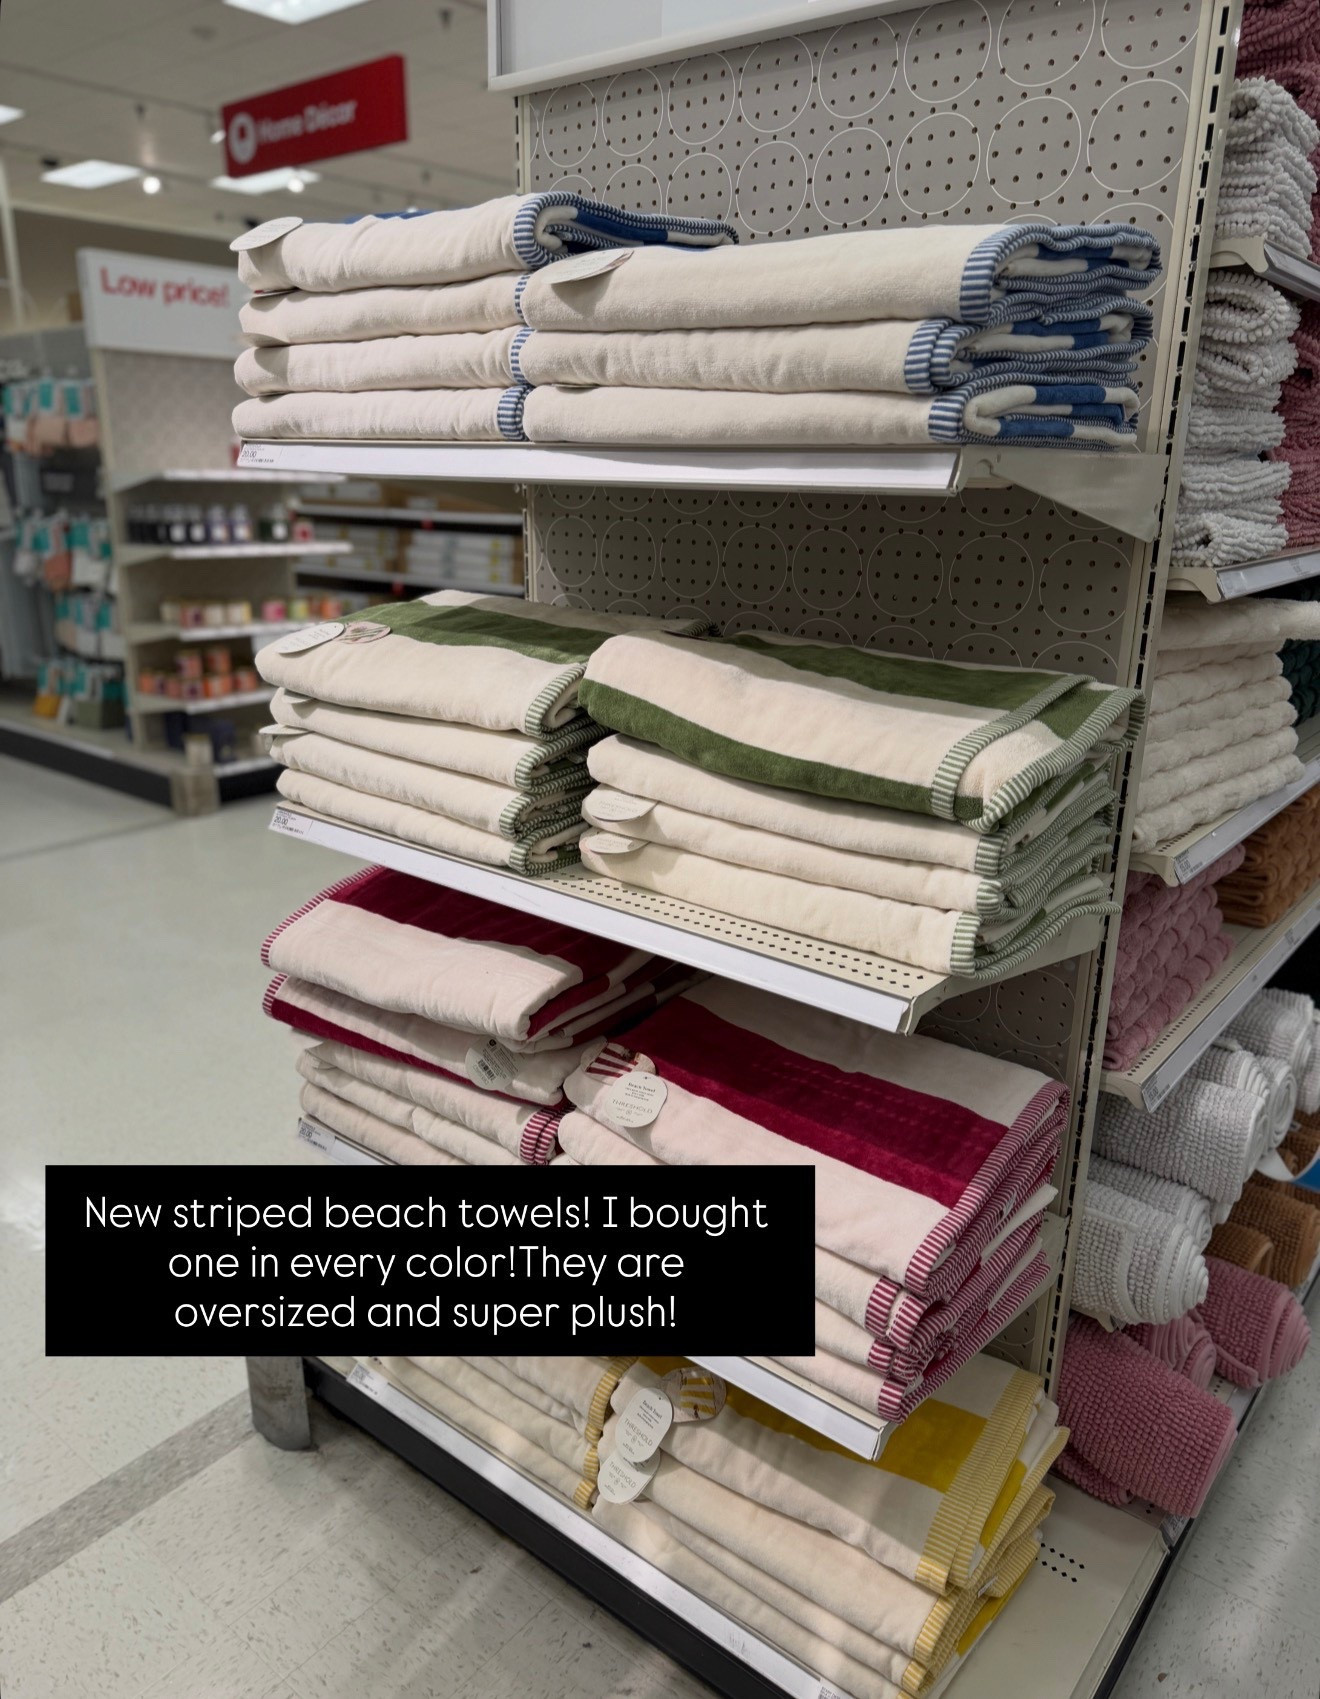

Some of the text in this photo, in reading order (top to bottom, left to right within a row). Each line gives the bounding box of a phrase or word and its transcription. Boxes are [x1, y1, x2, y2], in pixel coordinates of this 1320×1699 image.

[258, 114, 304, 145] Home
[101, 265, 230, 309] Low price!
[274, 815, 289, 826] 20.00
[612, 1098, 653, 1114] THRESHOLD
[625, 1418, 653, 1446] THRESHOLD
[609, 1461, 637, 1489] THRESHOLD
